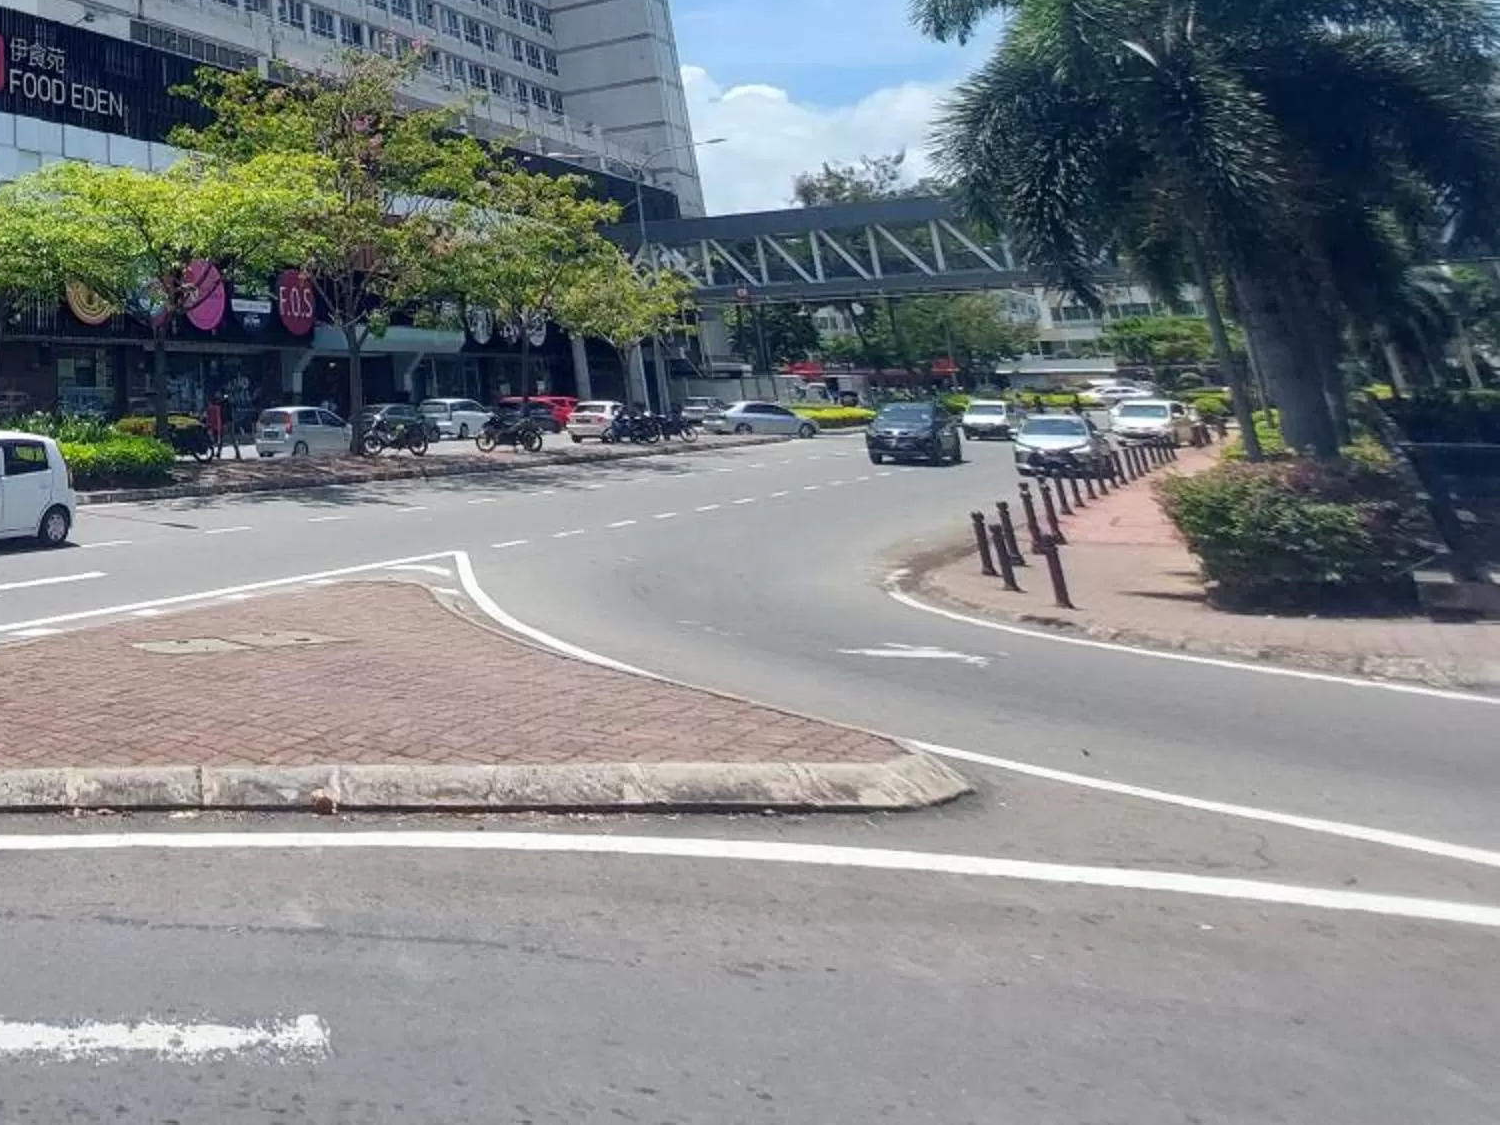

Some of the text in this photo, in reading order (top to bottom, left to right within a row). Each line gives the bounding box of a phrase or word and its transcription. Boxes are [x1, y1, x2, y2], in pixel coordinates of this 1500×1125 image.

[10, 37, 66, 73] 伊食苑
[9, 68, 123, 118] FOOD EDEN
